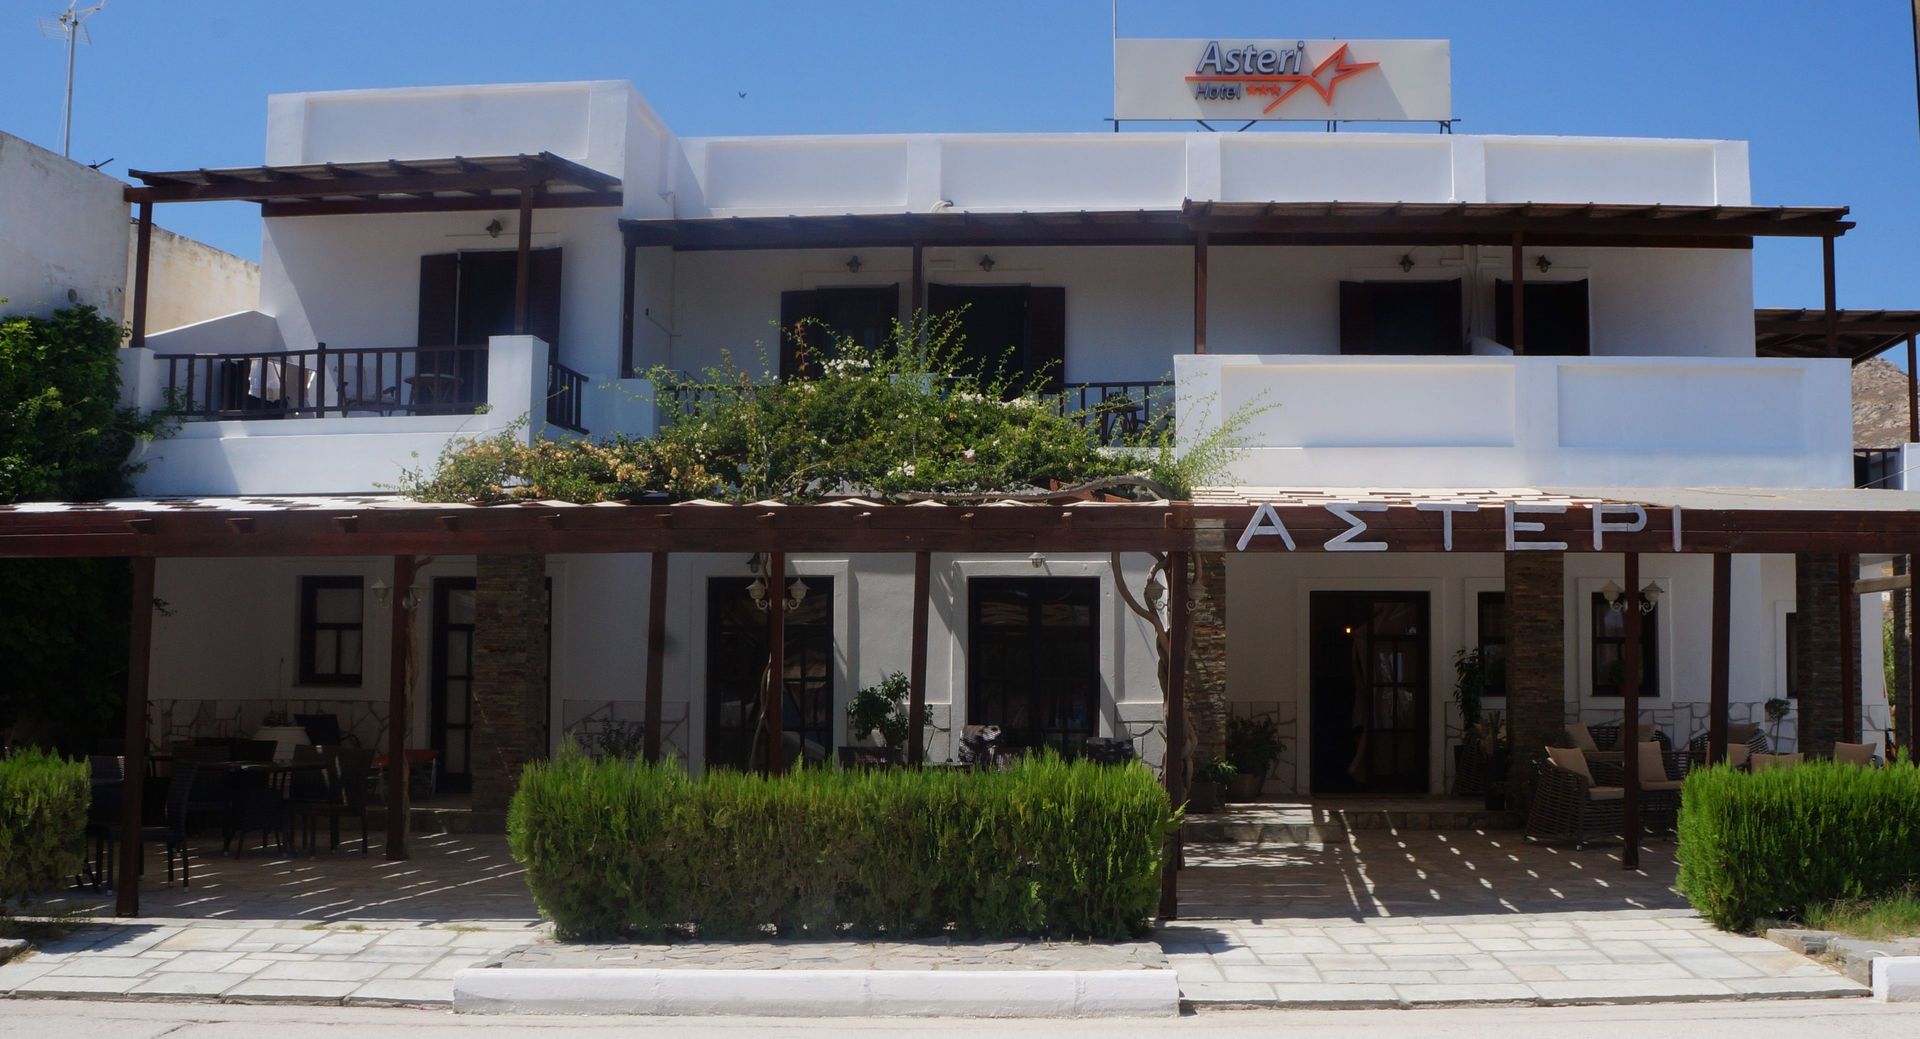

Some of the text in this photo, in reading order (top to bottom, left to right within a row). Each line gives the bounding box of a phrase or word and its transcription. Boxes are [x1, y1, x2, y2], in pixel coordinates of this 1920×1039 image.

[1195, 41, 1304, 74] Asteri
[1195, 82, 1241, 100] Hotel
[1236, 503, 1681, 552] ΑΣΤΕΡΙ
